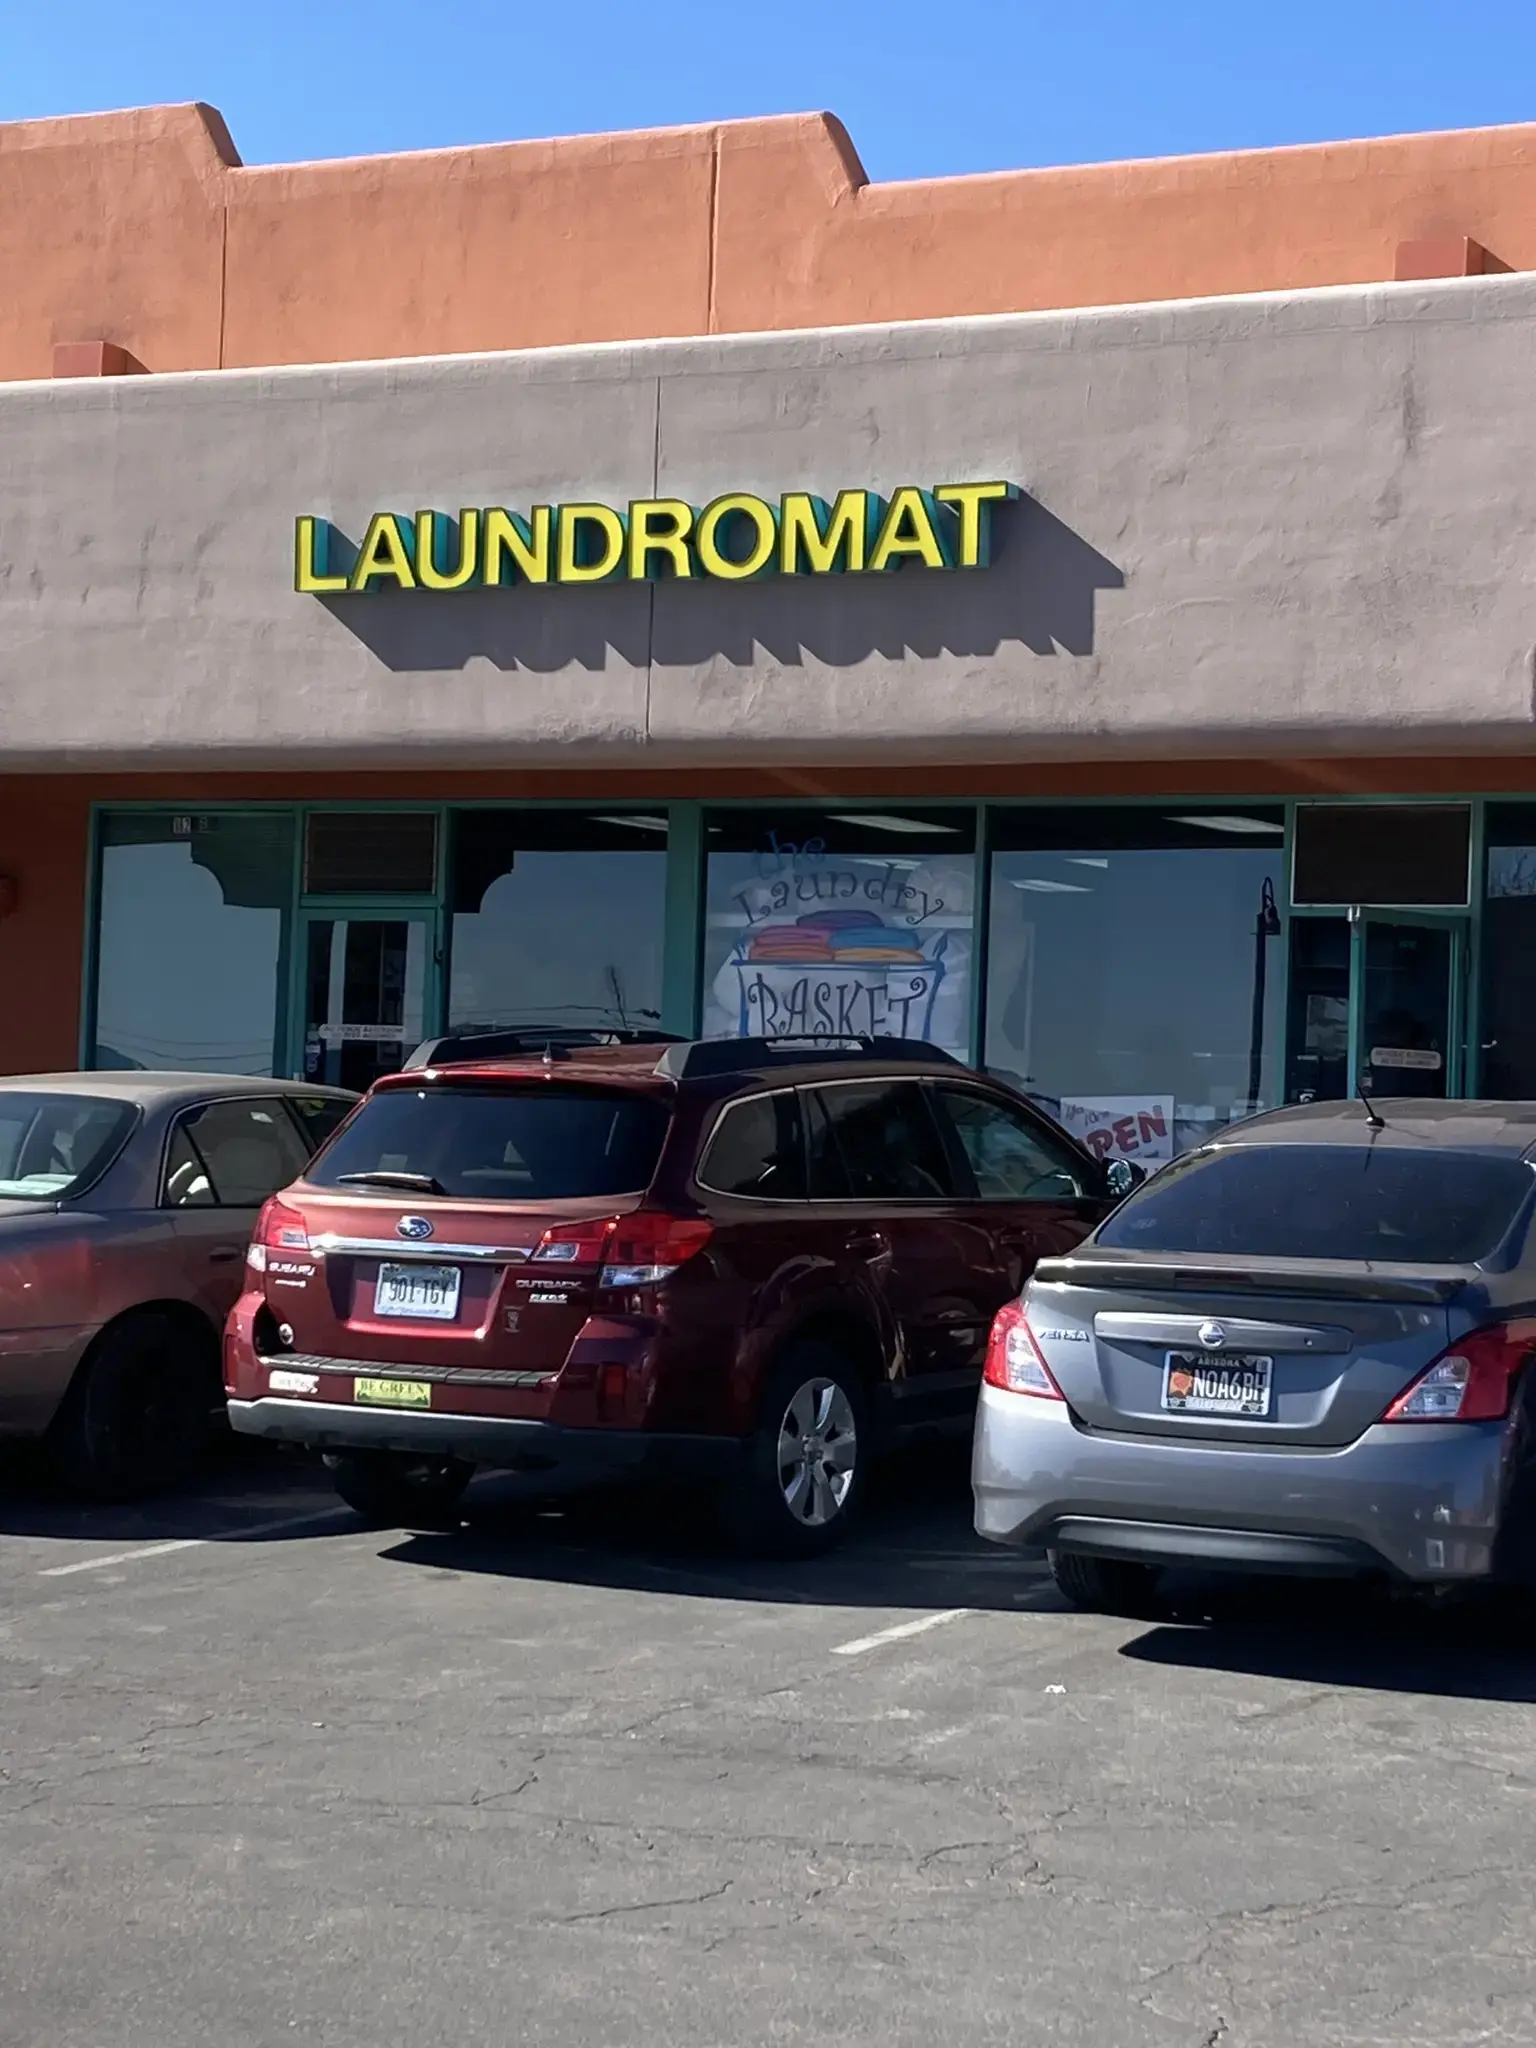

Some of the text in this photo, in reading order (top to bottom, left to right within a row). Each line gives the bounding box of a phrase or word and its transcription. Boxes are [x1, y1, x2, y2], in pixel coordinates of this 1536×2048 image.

[295, 482, 1018, 593] LAUNDROMAT
[754, 829, 826, 880] the
[733, 862, 944, 926] Laundry
[747, 972, 928, 1046] BASKET
[1080, 1104, 1168, 1160] PEN
[380, 1382, 425, 1394] GREEN
[1198, 1357, 1240, 1367] ARIZONA
